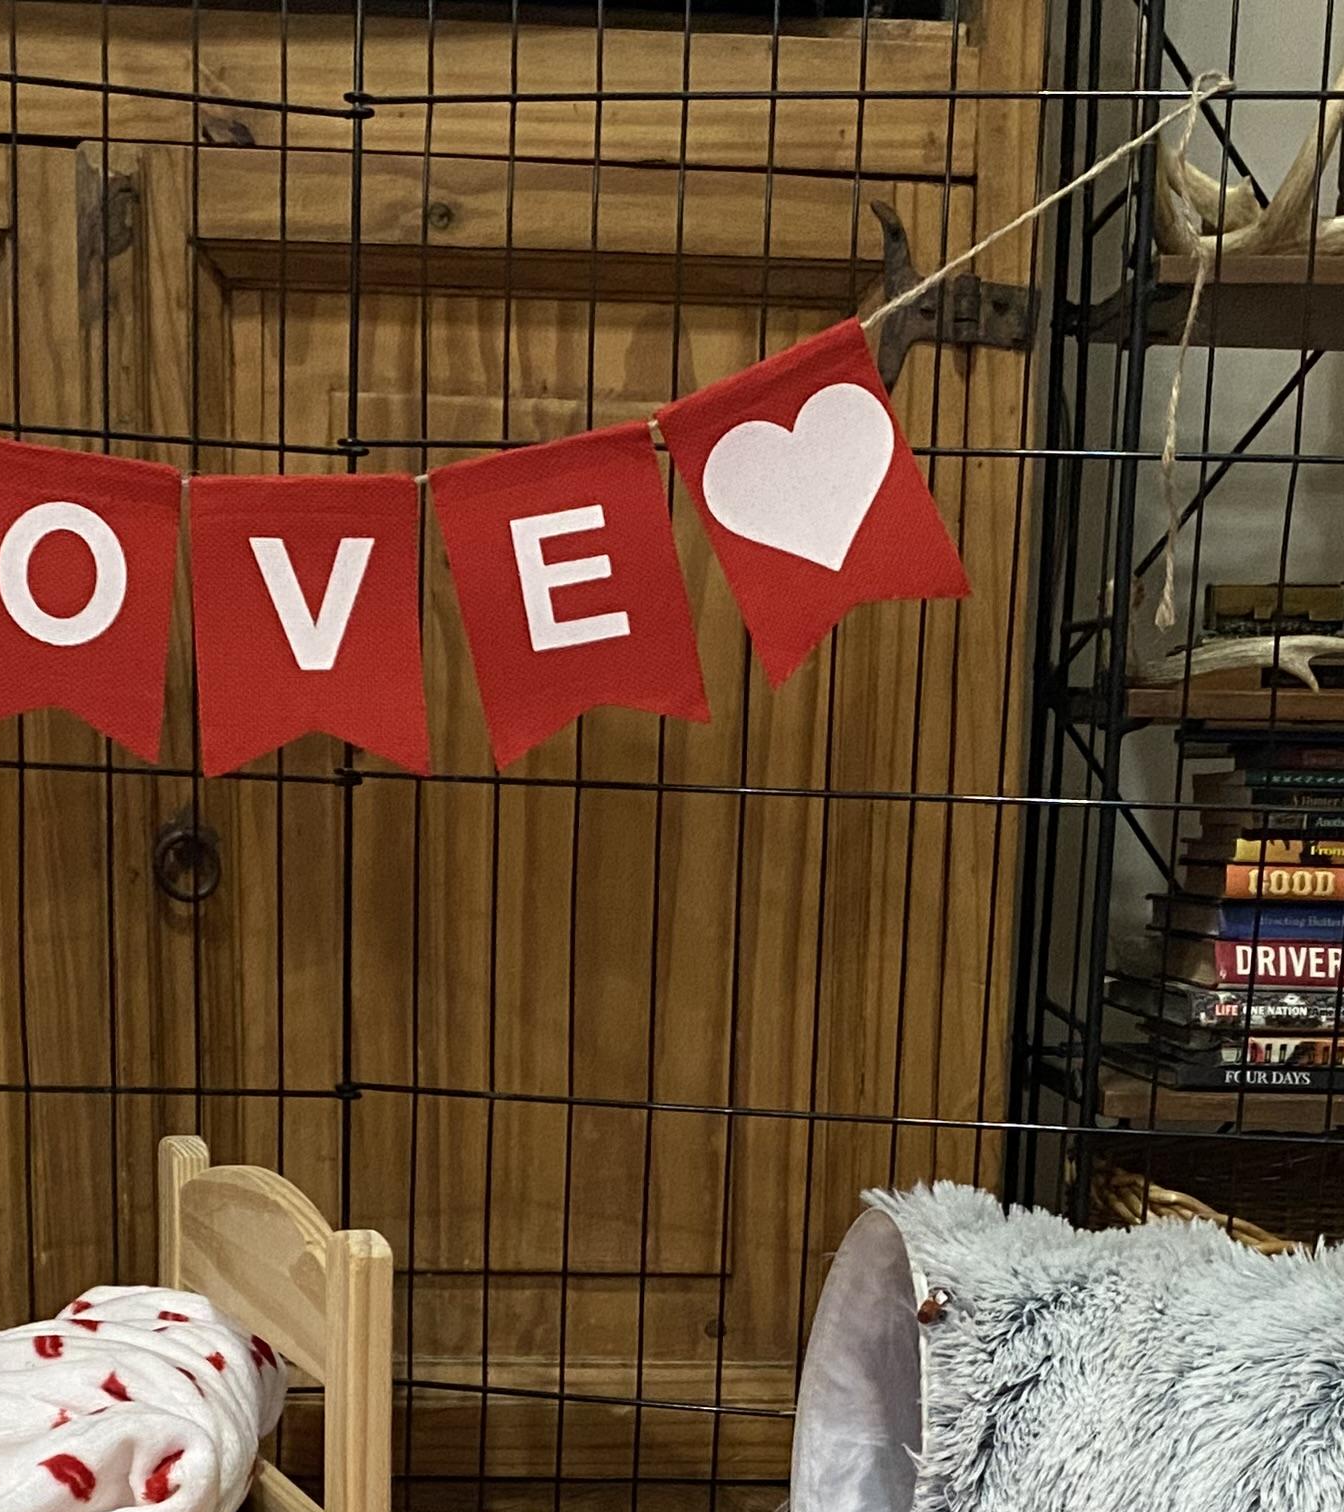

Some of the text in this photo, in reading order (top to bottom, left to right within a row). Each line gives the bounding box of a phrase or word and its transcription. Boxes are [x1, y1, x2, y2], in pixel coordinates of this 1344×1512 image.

[1248, 867, 1336, 897] GOOD
[1215, 1004, 1239, 1016] LIFE
[1267, 1005, 1307, 1016] NATION
[1225, 1070, 1311, 1085] FOUR DAYS
